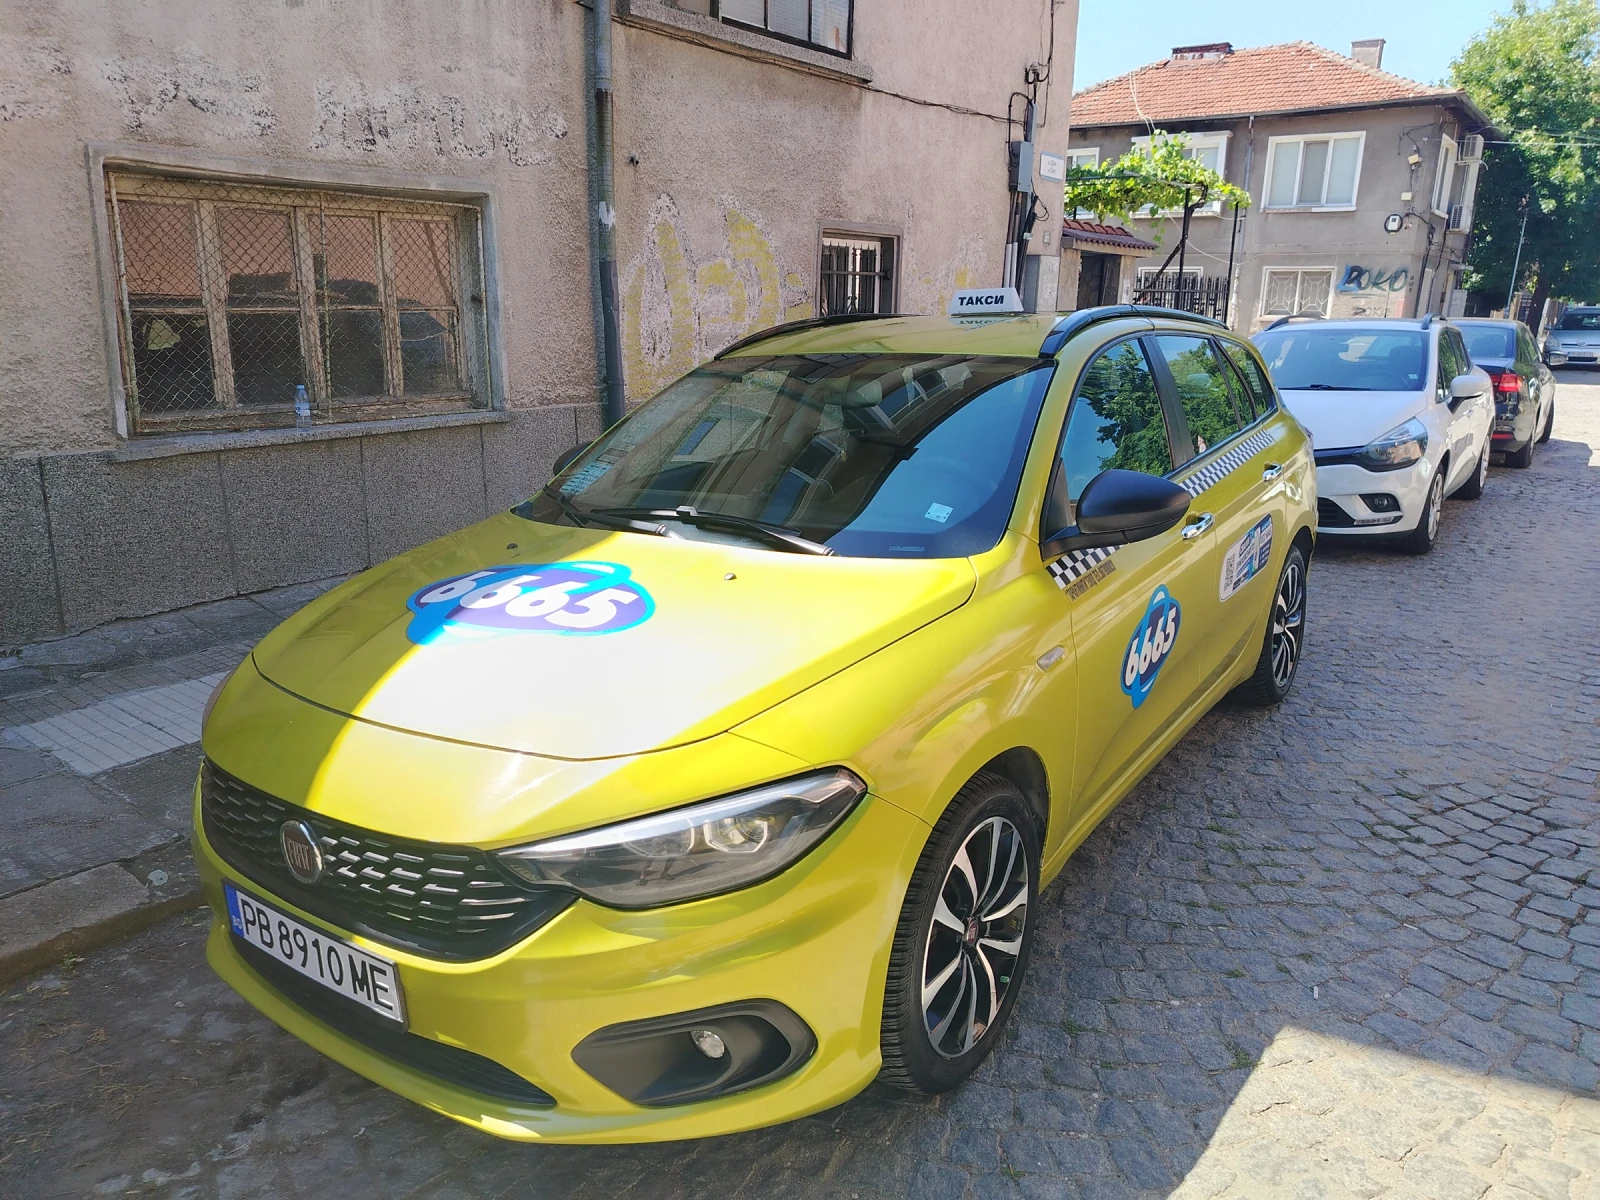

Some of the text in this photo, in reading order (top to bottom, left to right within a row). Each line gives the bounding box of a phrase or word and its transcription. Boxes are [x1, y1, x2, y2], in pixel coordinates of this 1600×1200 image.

[958, 295, 1005, 306] ТАКСИ
[419, 571, 639, 628] 6665
[1125, 606, 1177, 687] 6665
[286, 837, 310, 871] FIAT
[231, 914, 243, 930] BG
[240, 898, 394, 1012] PB 8910 ME
